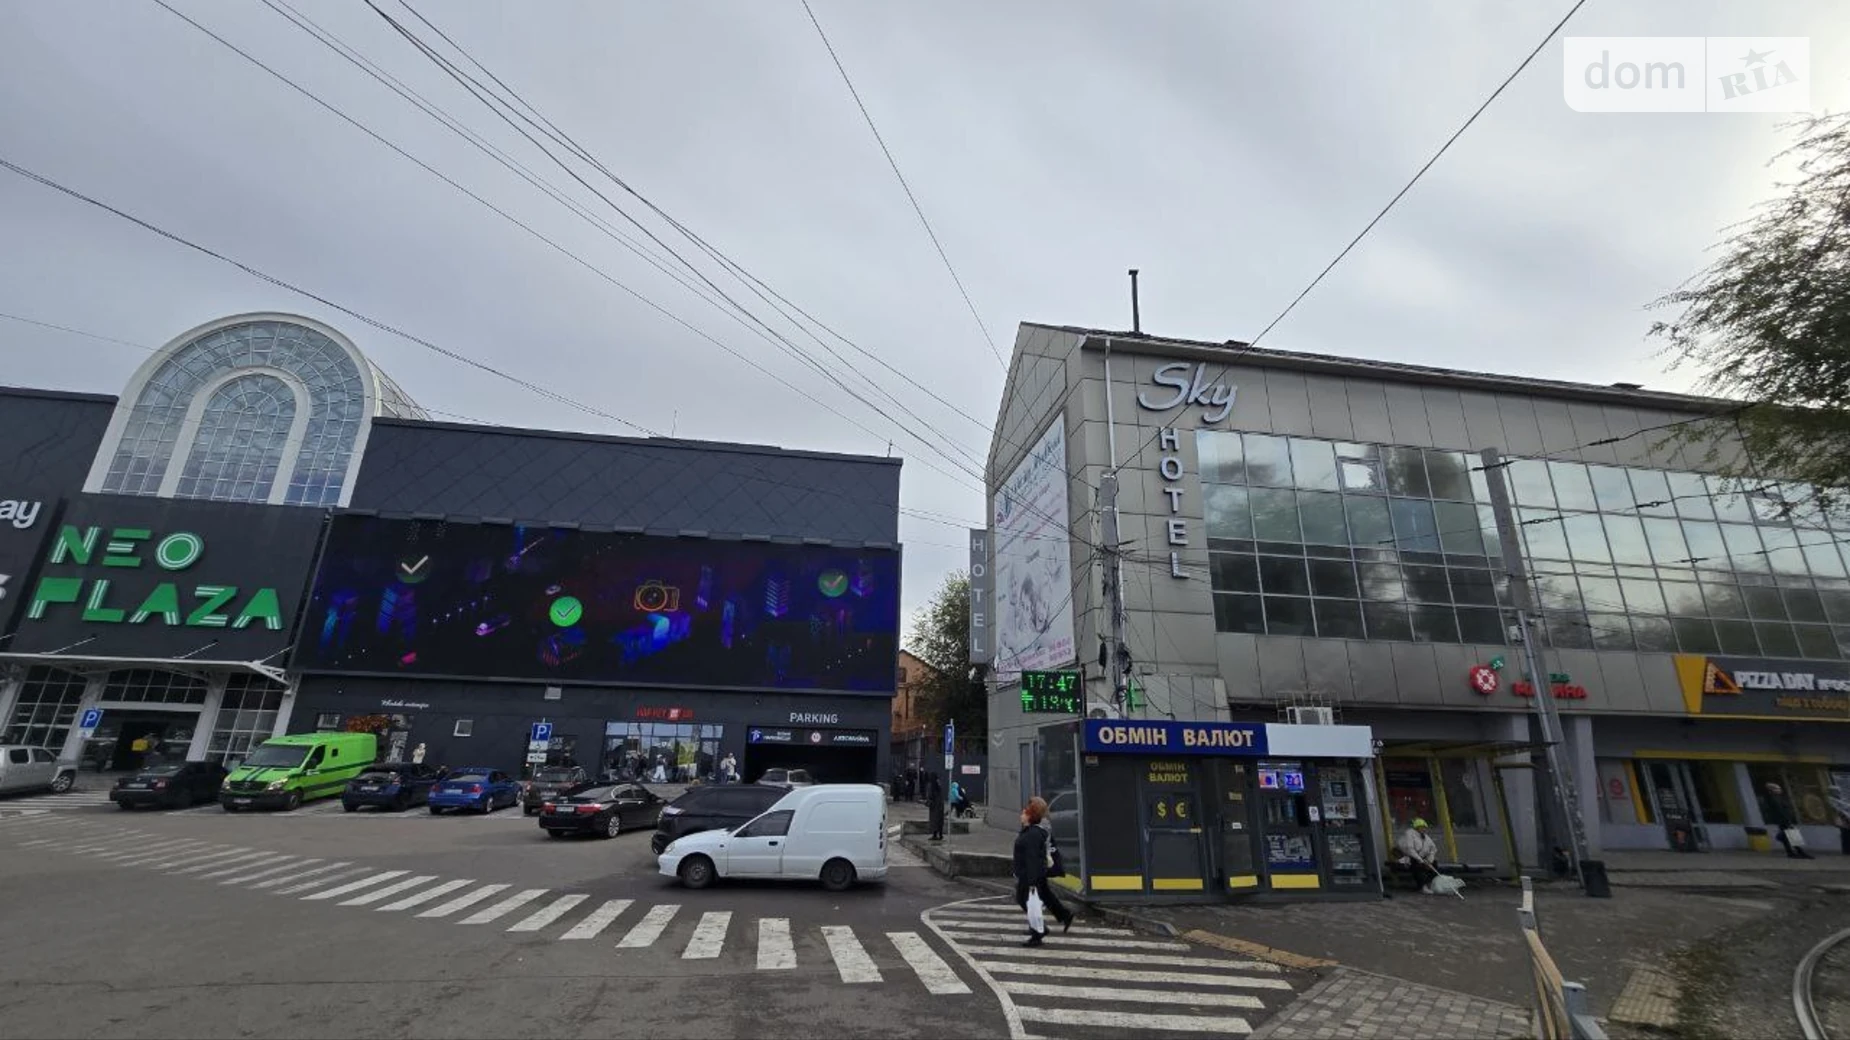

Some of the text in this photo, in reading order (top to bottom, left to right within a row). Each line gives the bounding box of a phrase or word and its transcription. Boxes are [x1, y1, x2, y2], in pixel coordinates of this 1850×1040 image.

[1138, 362, 1238, 424] Sky
[1158, 426, 1192, 578] HOTEL
[51, 525, 204, 571] NEO
[28, 577, 284, 630] PLAZA
[970, 538, 986, 654] HOTEL
[789, 712, 838, 724] PARKING
[1098, 726, 1254, 748] ОБМІН ВАЛЮТ
[1149, 773, 1188, 783] ВАЛЮТ
